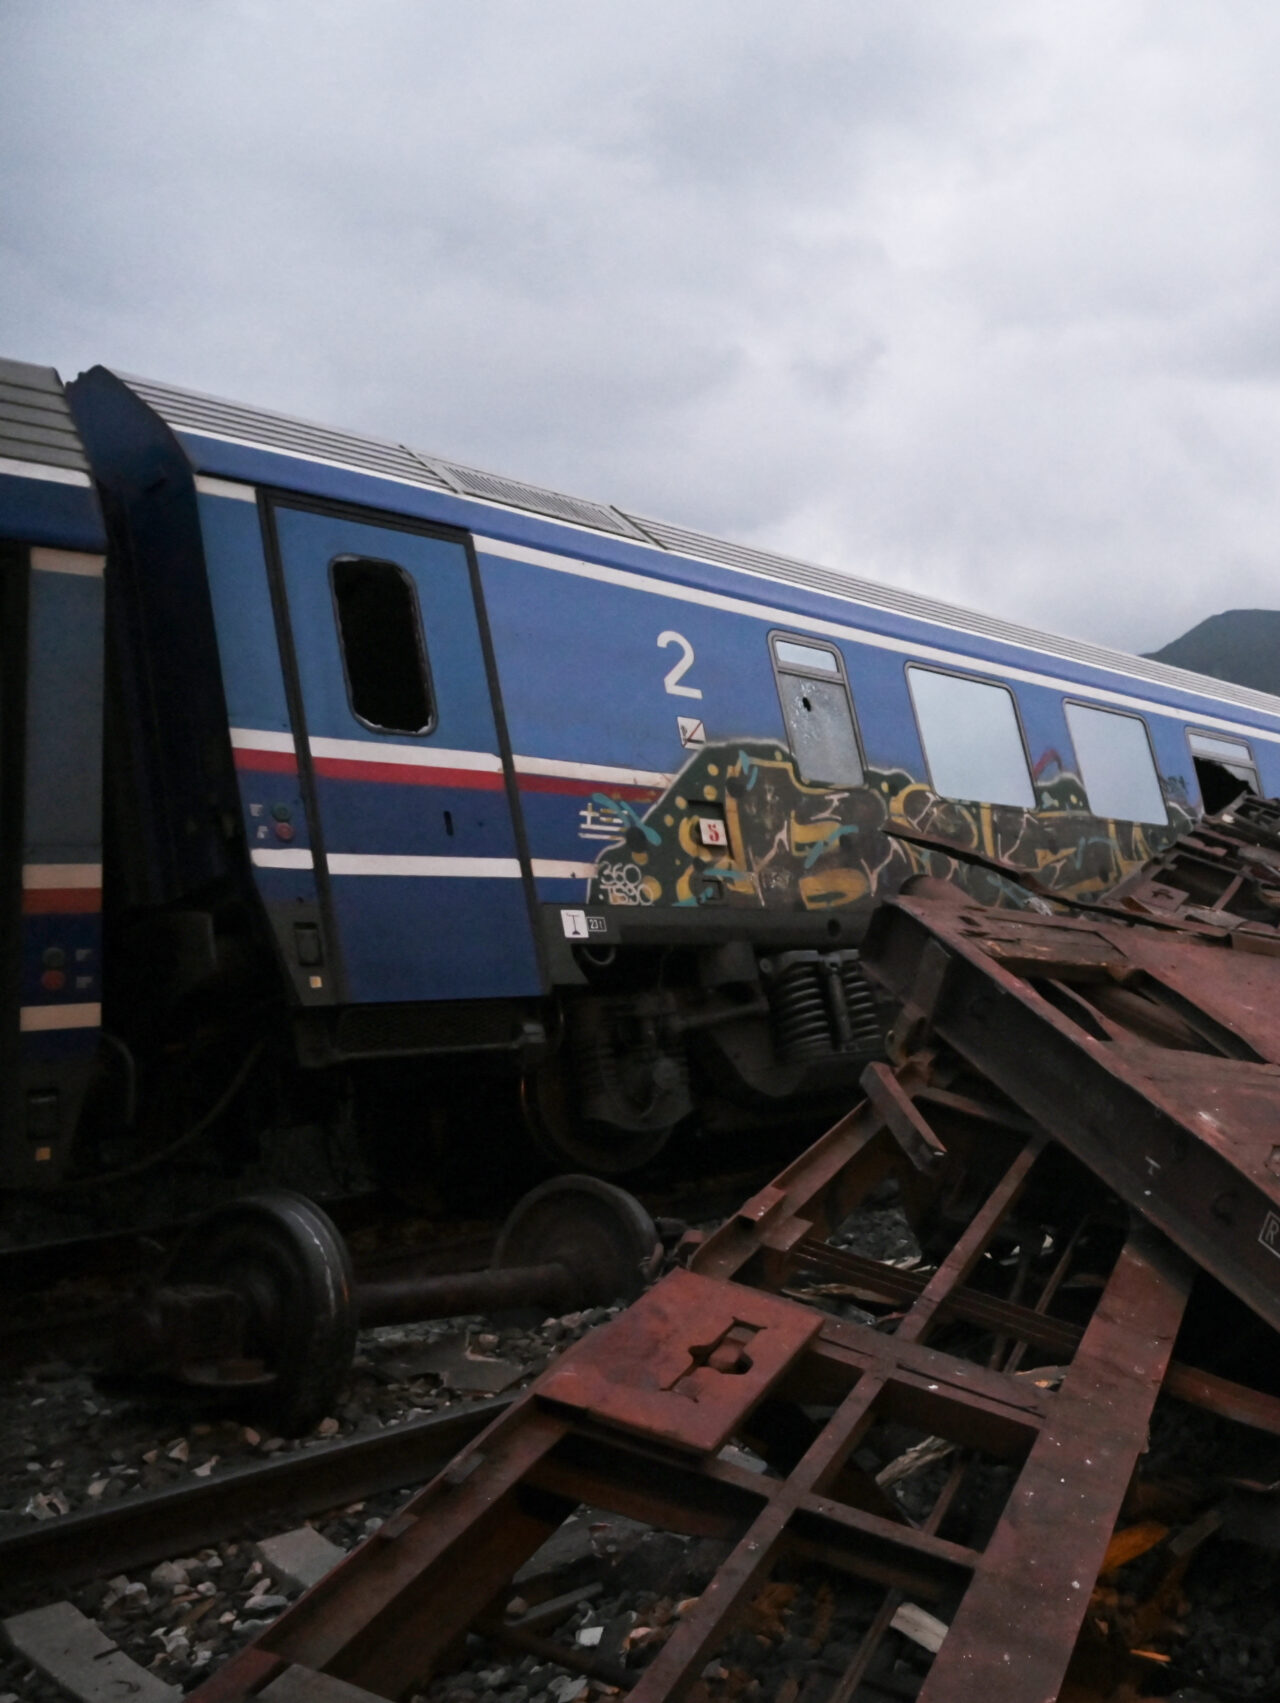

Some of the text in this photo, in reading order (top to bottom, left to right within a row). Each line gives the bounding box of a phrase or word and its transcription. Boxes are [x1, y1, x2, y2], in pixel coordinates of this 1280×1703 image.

[657, 630, 703, 700] 2
[707, 823, 720, 842] 5
[600, 861, 642, 885] 360
[1264, 1219, 1279, 1245] R
